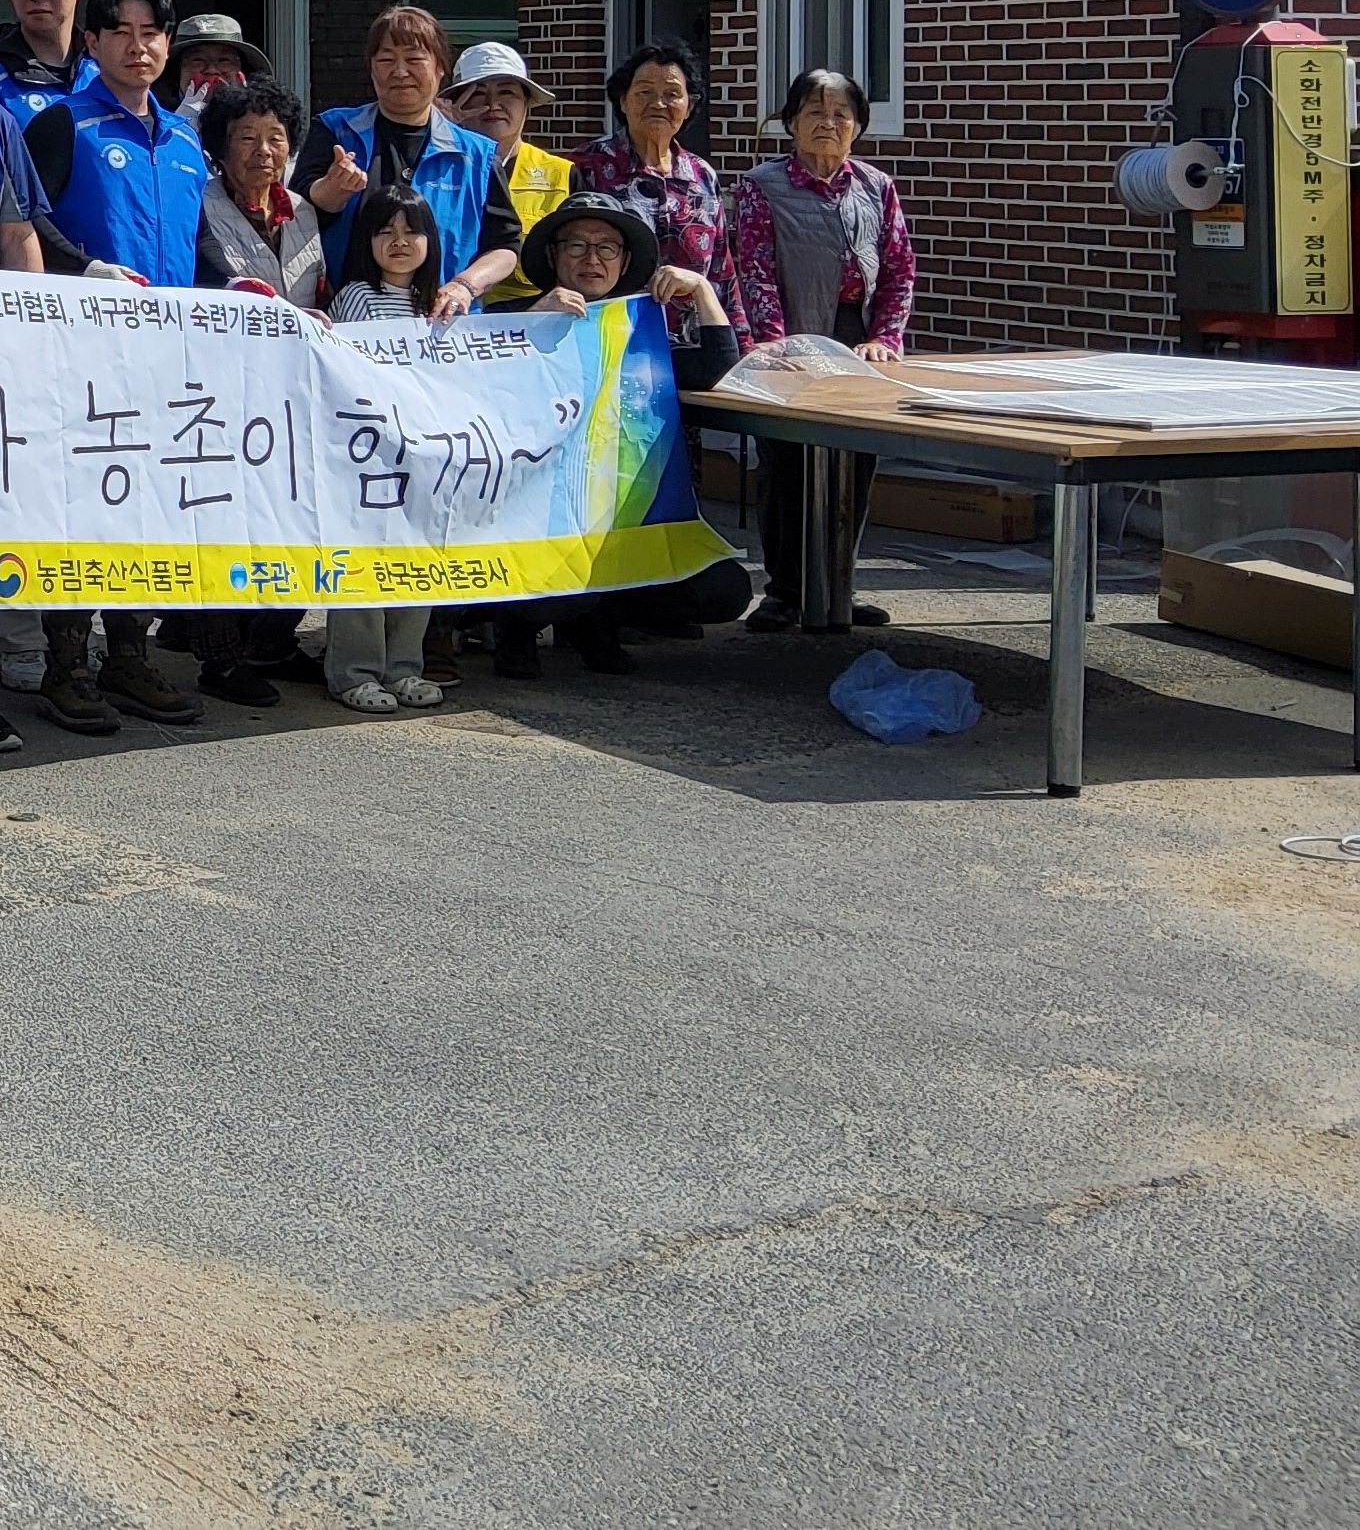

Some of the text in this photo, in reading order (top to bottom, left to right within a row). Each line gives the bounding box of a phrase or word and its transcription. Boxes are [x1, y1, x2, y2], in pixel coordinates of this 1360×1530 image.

[79, 295, 184, 332] 대구광역시
[418, 328, 532, 365] 재능나눔본부
[72, 382, 300, 510] 농촌이
[35, 558, 195, 594] 농림축산식품부
[249, 559, 299, 594] 주관:
[371, 556, 511, 593] 한국농어촌공사
